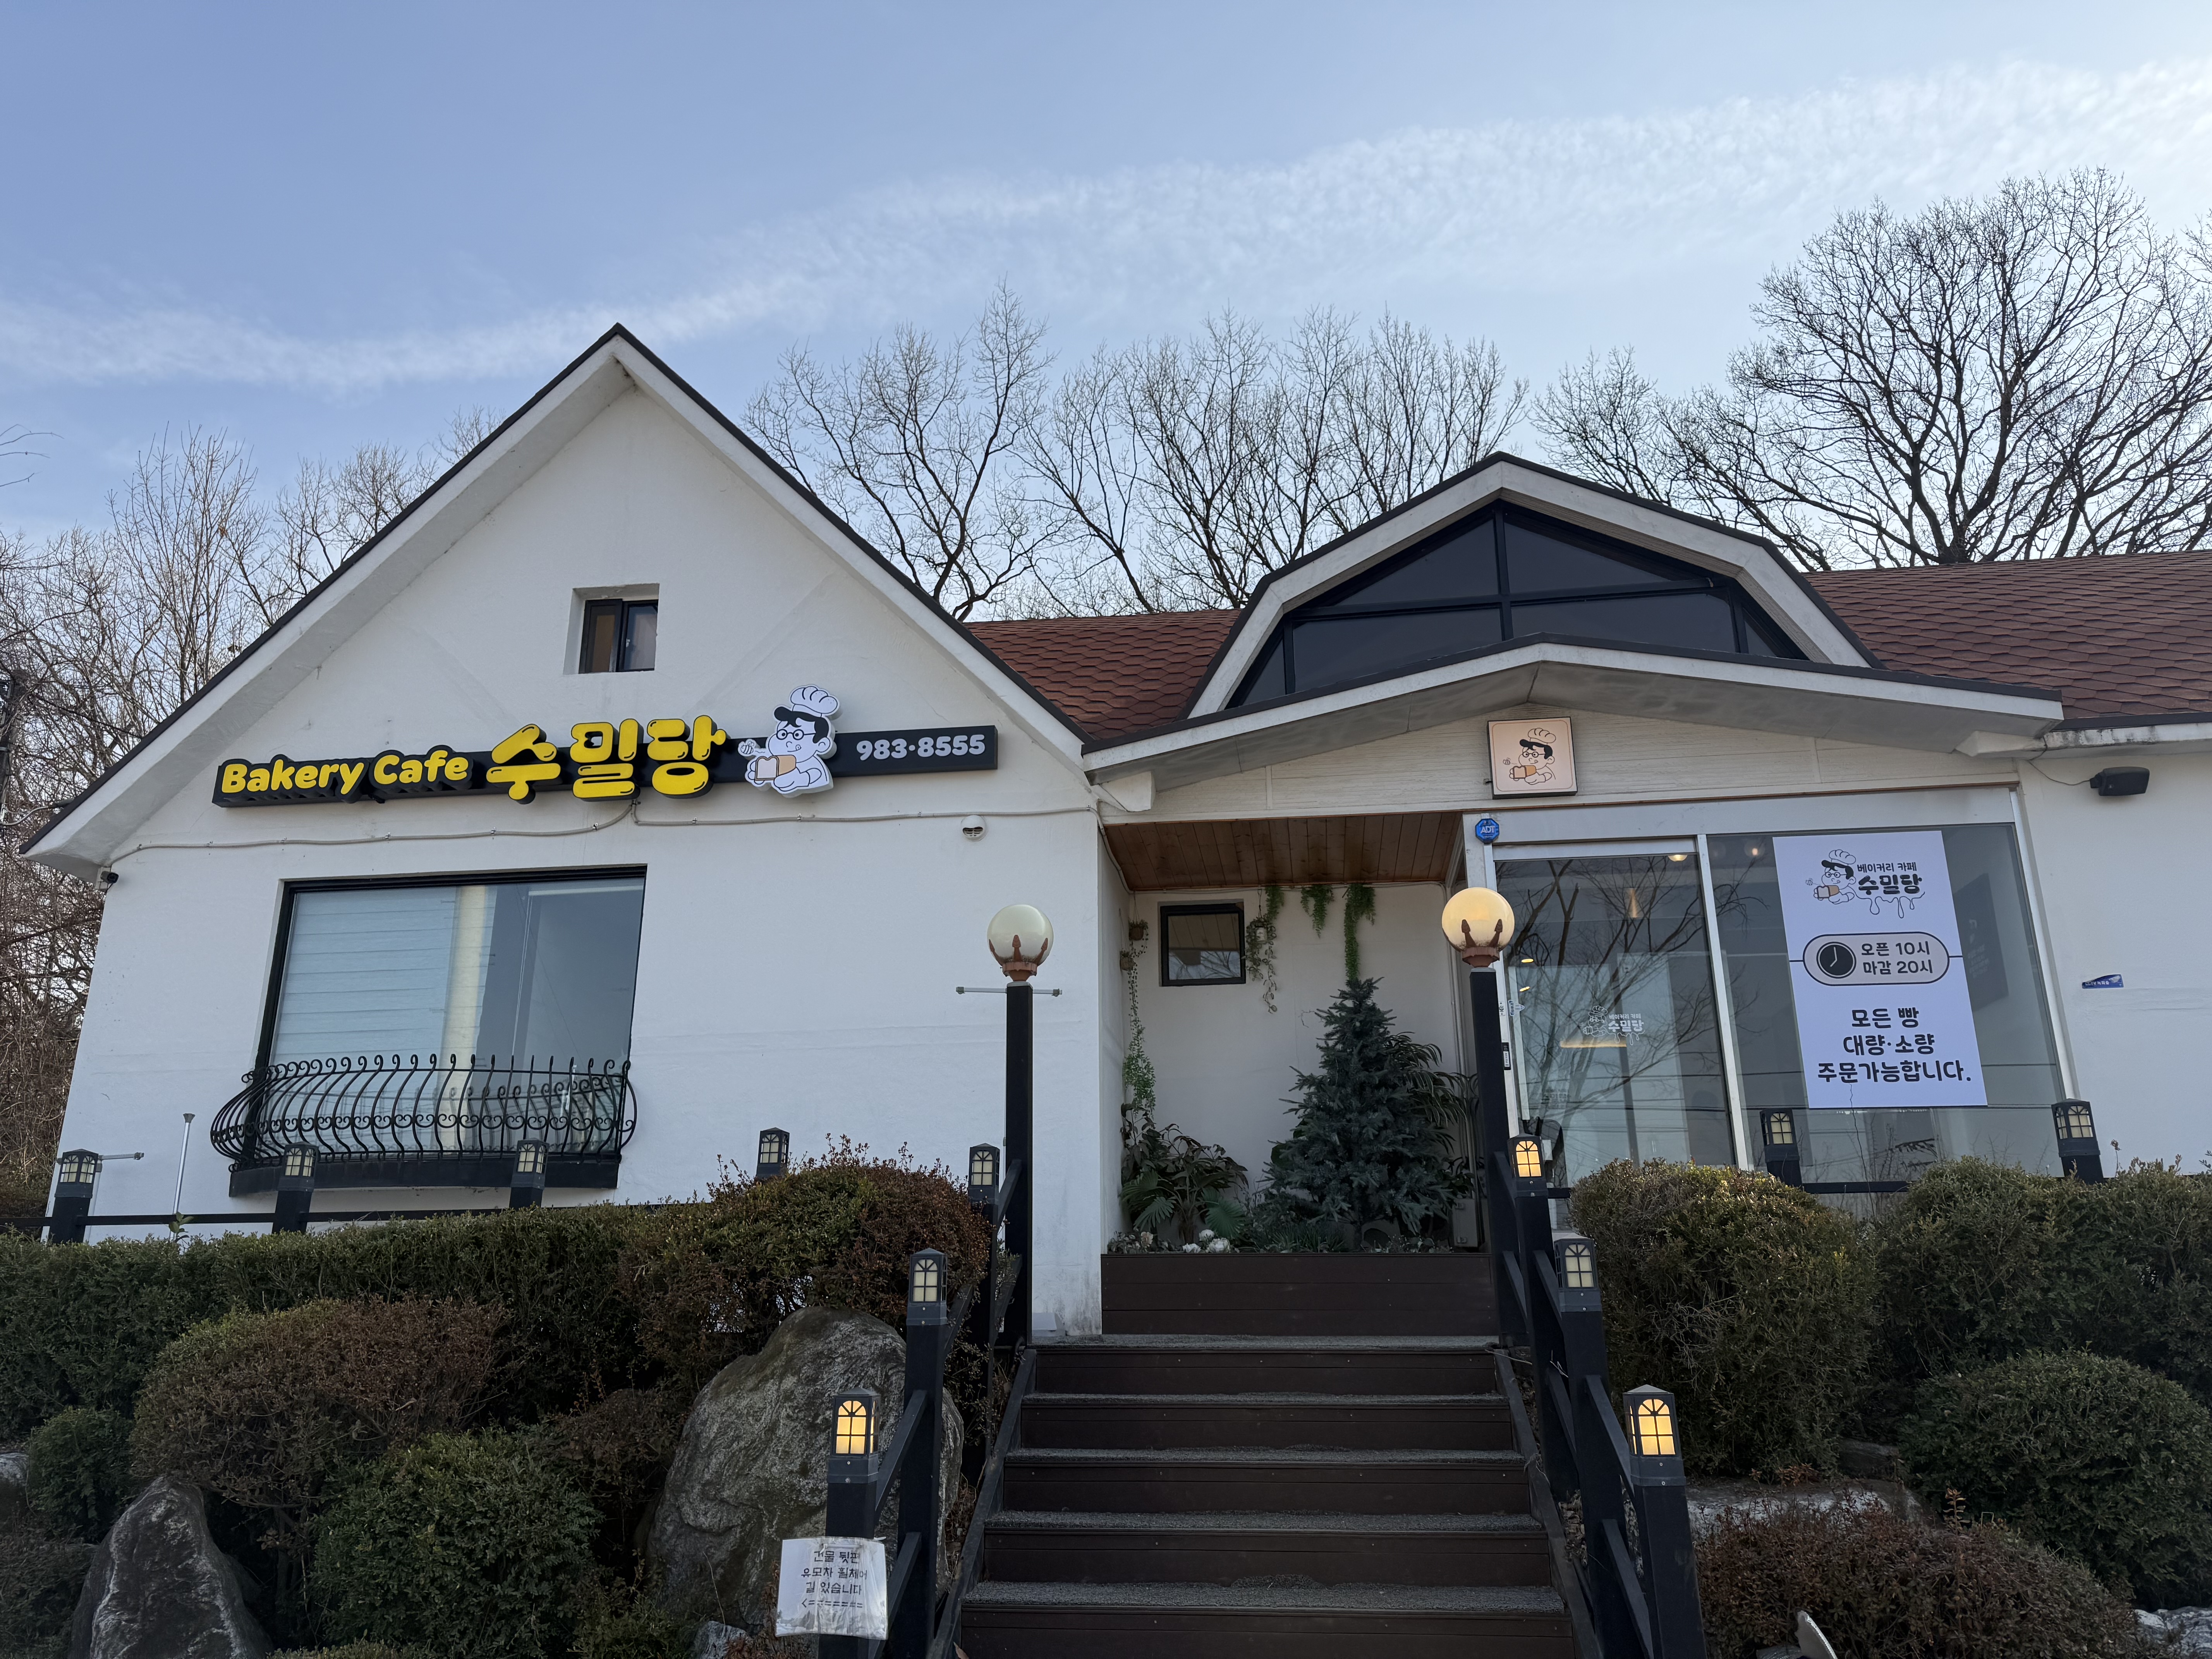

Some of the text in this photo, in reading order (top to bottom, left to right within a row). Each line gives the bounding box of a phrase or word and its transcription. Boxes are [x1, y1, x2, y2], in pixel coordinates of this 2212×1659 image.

[486, 715, 726, 800] 수밀당
[221, 750, 469, 795] Bakery Cafe
[1857, 862, 1917, 873] 베이커리 카페
[1858, 874, 1922, 895] 수밀당
[1861, 941, 1930, 957] 오픈 10시
[1863, 959, 1933, 975] 마감 20시
[1608, 1019, 1644, 1032] 수밀당
[1851, 1007, 1919, 1029] 모든 빵
[1818, 1060, 1972, 1083] 주문가능합니다.
[814, 1551, 835, 1562] 건물
[801, 1567, 867, 1580] 유모차 휠체어
[806, 1581, 862, 1595] 길 있습니다
